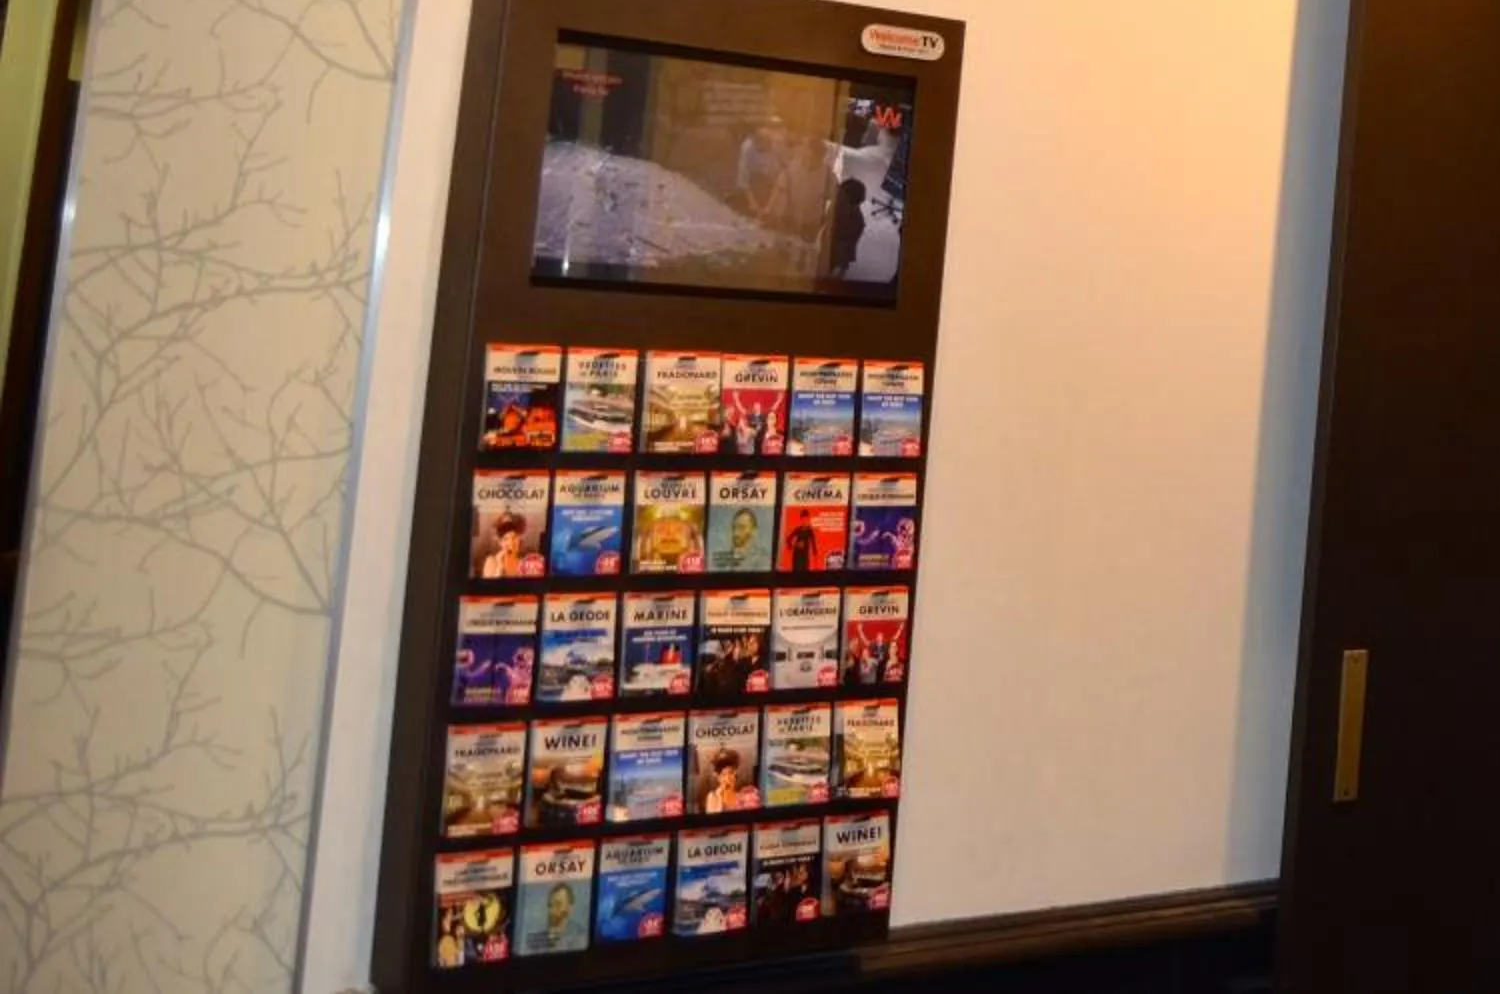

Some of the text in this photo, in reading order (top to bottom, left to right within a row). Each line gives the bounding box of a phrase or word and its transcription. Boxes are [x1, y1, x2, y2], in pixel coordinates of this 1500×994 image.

[922, 36, 939, 49] TV
[477, 487, 545, 501] CHOCOLAT
[559, 483, 621, 495] AQUARIUM
[643, 487, 697, 500] LOUVRE
[719, 486, 768, 500] ORSAY
[550, 611, 566, 624] LA
[633, 608, 689, 623] MARINE
[694, 723, 755, 739] CHOCOLAT
[604, 846, 665, 862] AQUARIUM
[687, 846, 701, 859] LA
[535, 859, 588, 877] ORSAY
